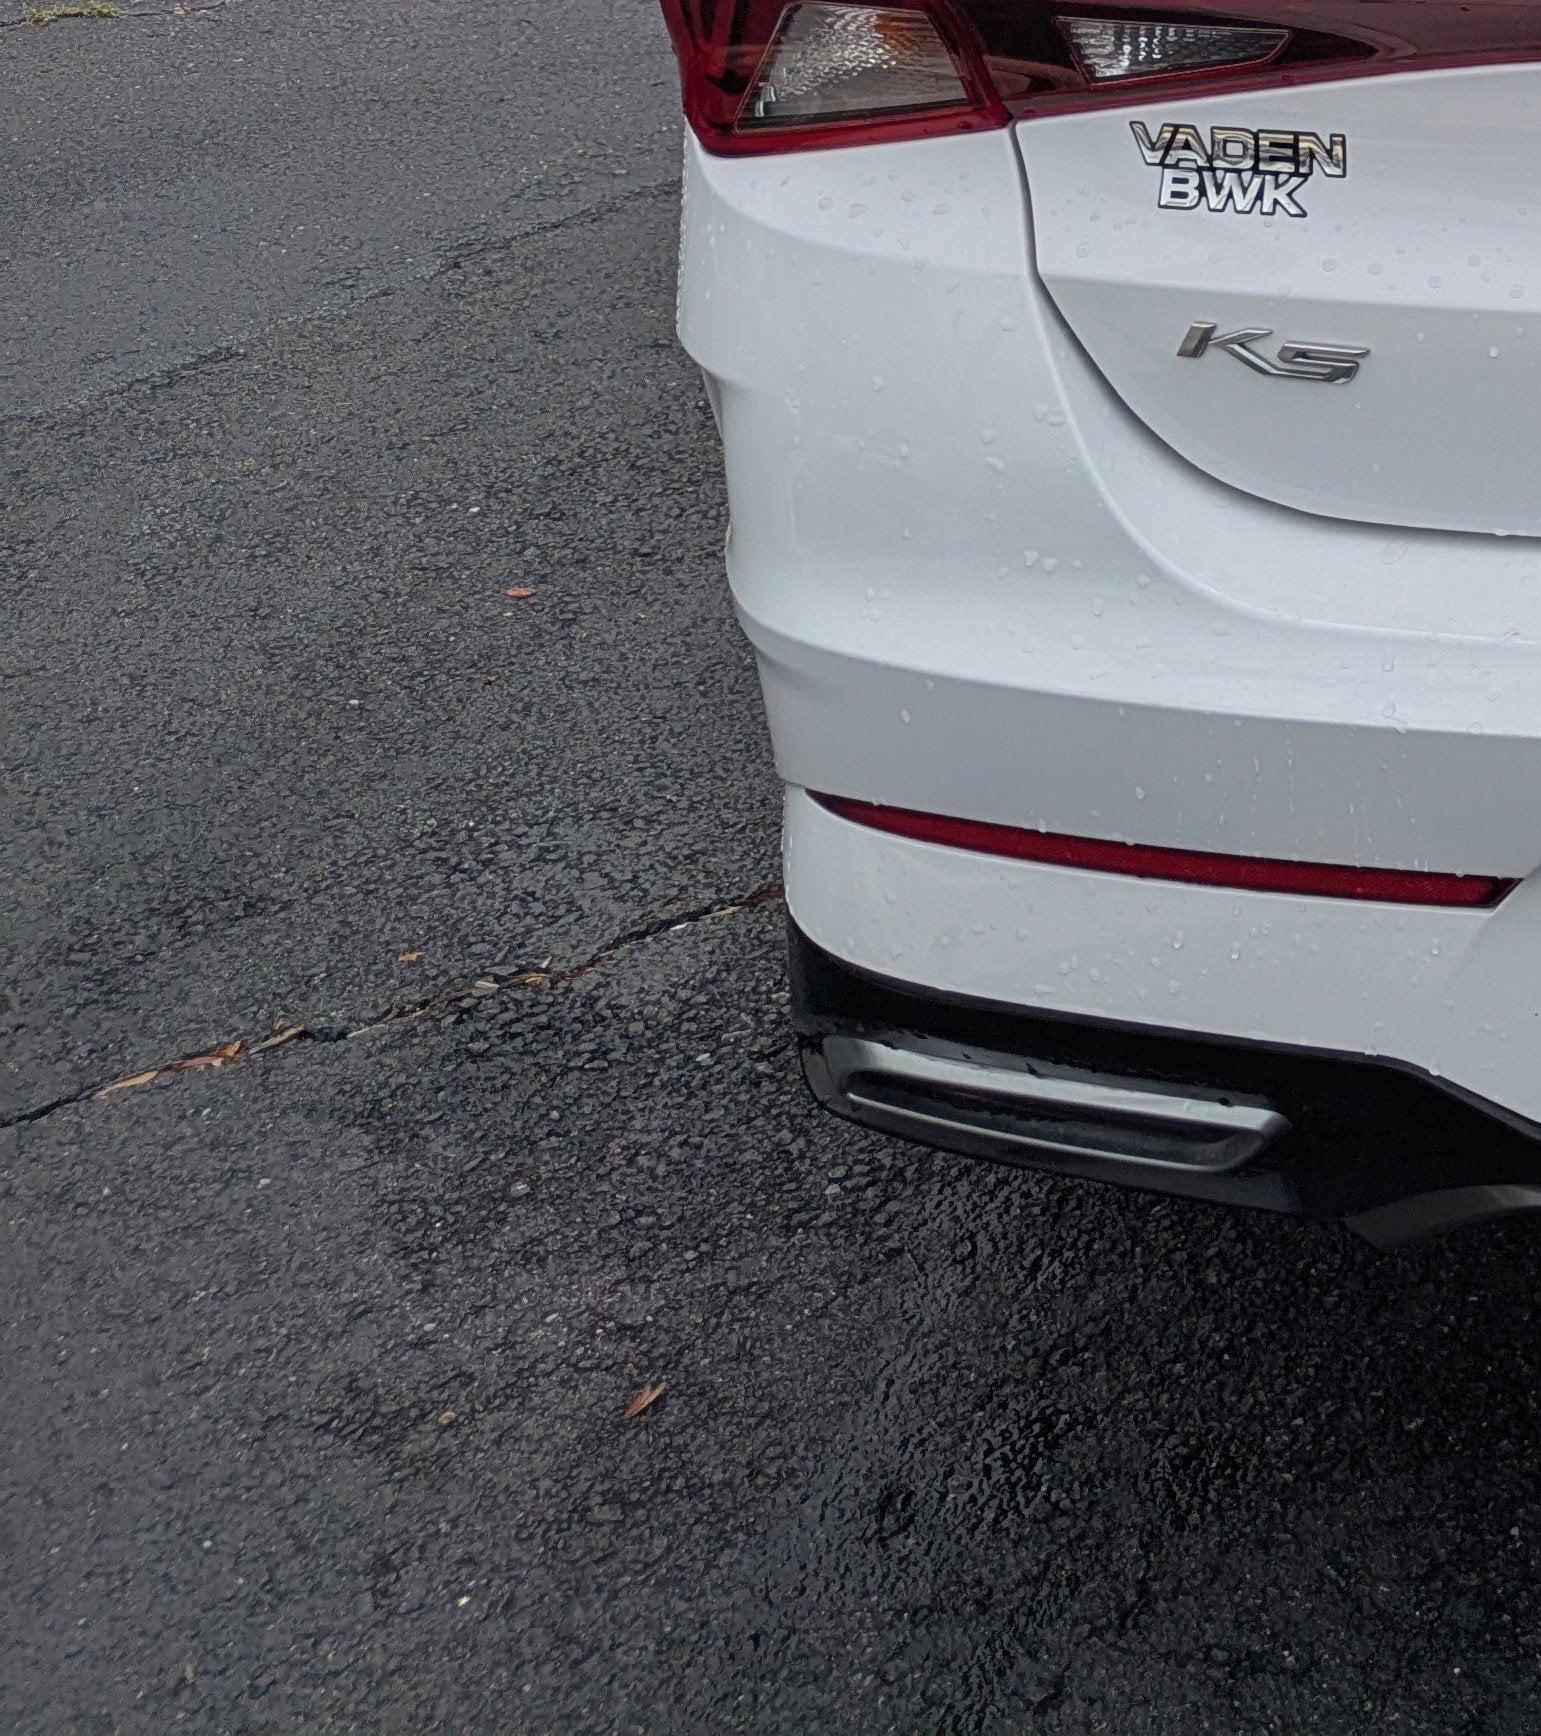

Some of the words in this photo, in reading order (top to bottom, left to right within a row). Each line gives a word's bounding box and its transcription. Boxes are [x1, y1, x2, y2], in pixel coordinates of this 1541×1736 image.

[1129, 121, 1346, 178] VADEN
[1158, 166, 1308, 218] BWK
[1176, 320, 1371, 385] K5
